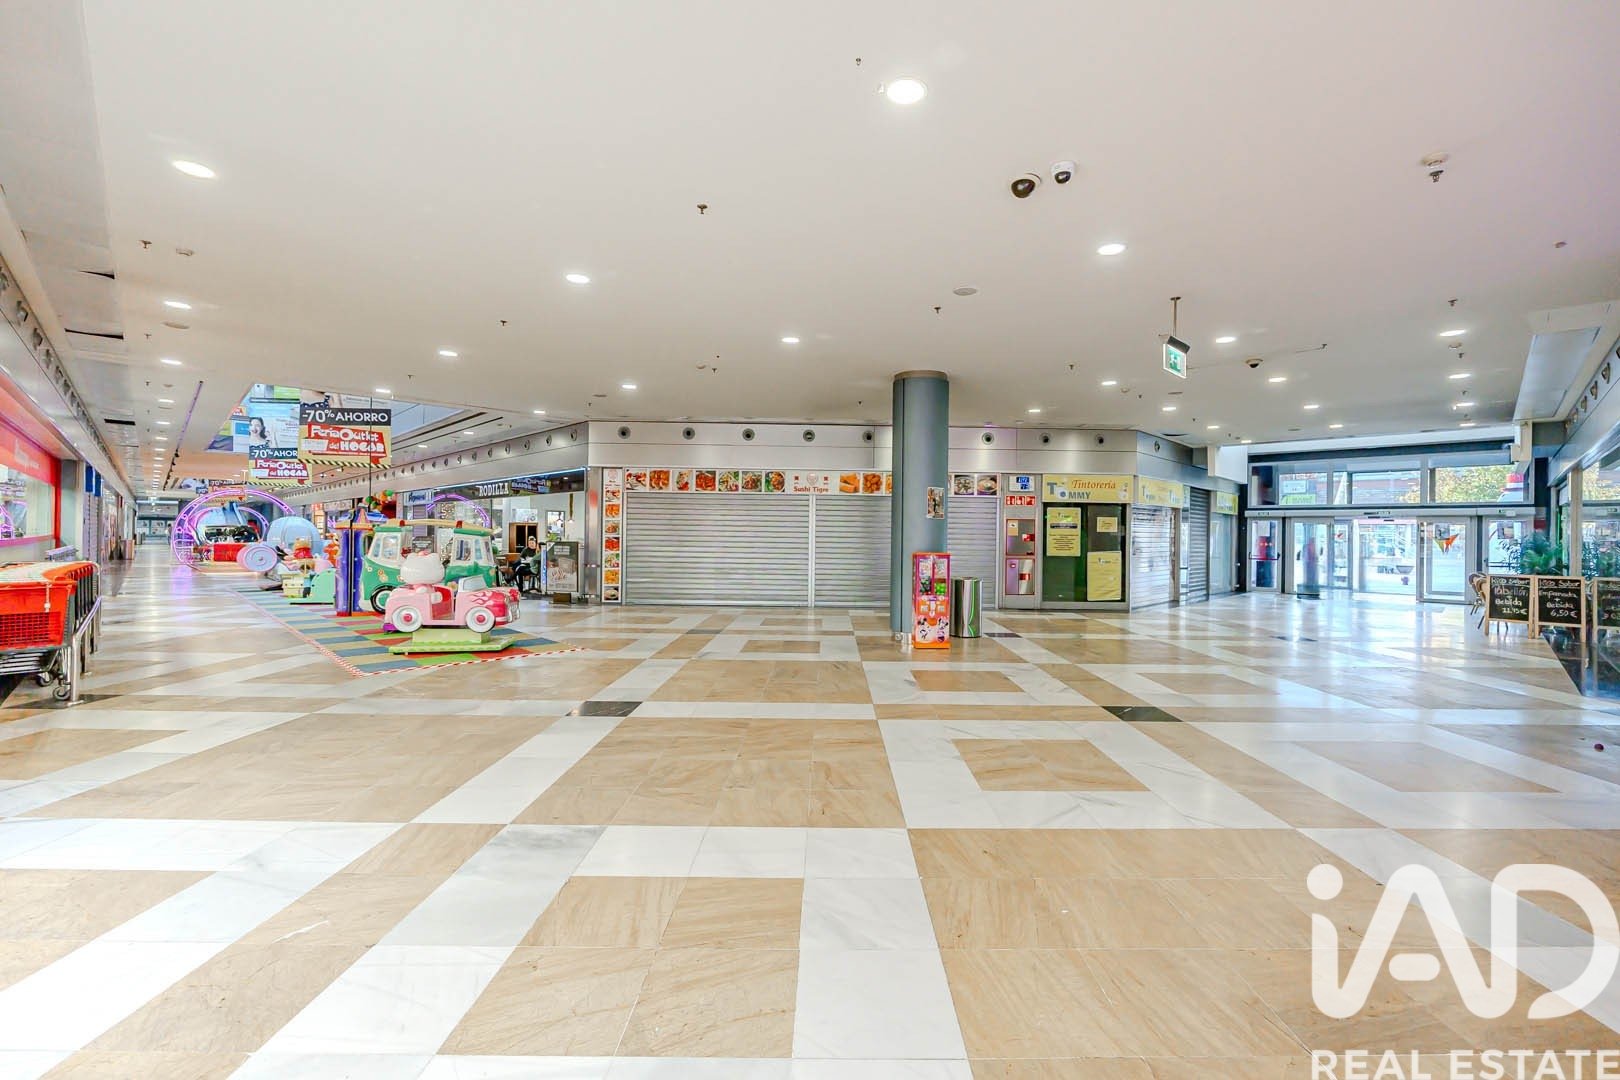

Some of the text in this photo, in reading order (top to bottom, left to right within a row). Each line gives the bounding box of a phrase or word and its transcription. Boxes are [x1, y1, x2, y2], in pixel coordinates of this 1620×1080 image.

[302, 409, 389, 423] -70% AHORRO
[311, 424, 340, 438] Feria
[340, 428, 379, 442] Outlet
[340, 441, 384, 452] HOGAR
[476, 482, 509, 497] RODILLA
[1071, 479, 1116, 489] Tintorería
